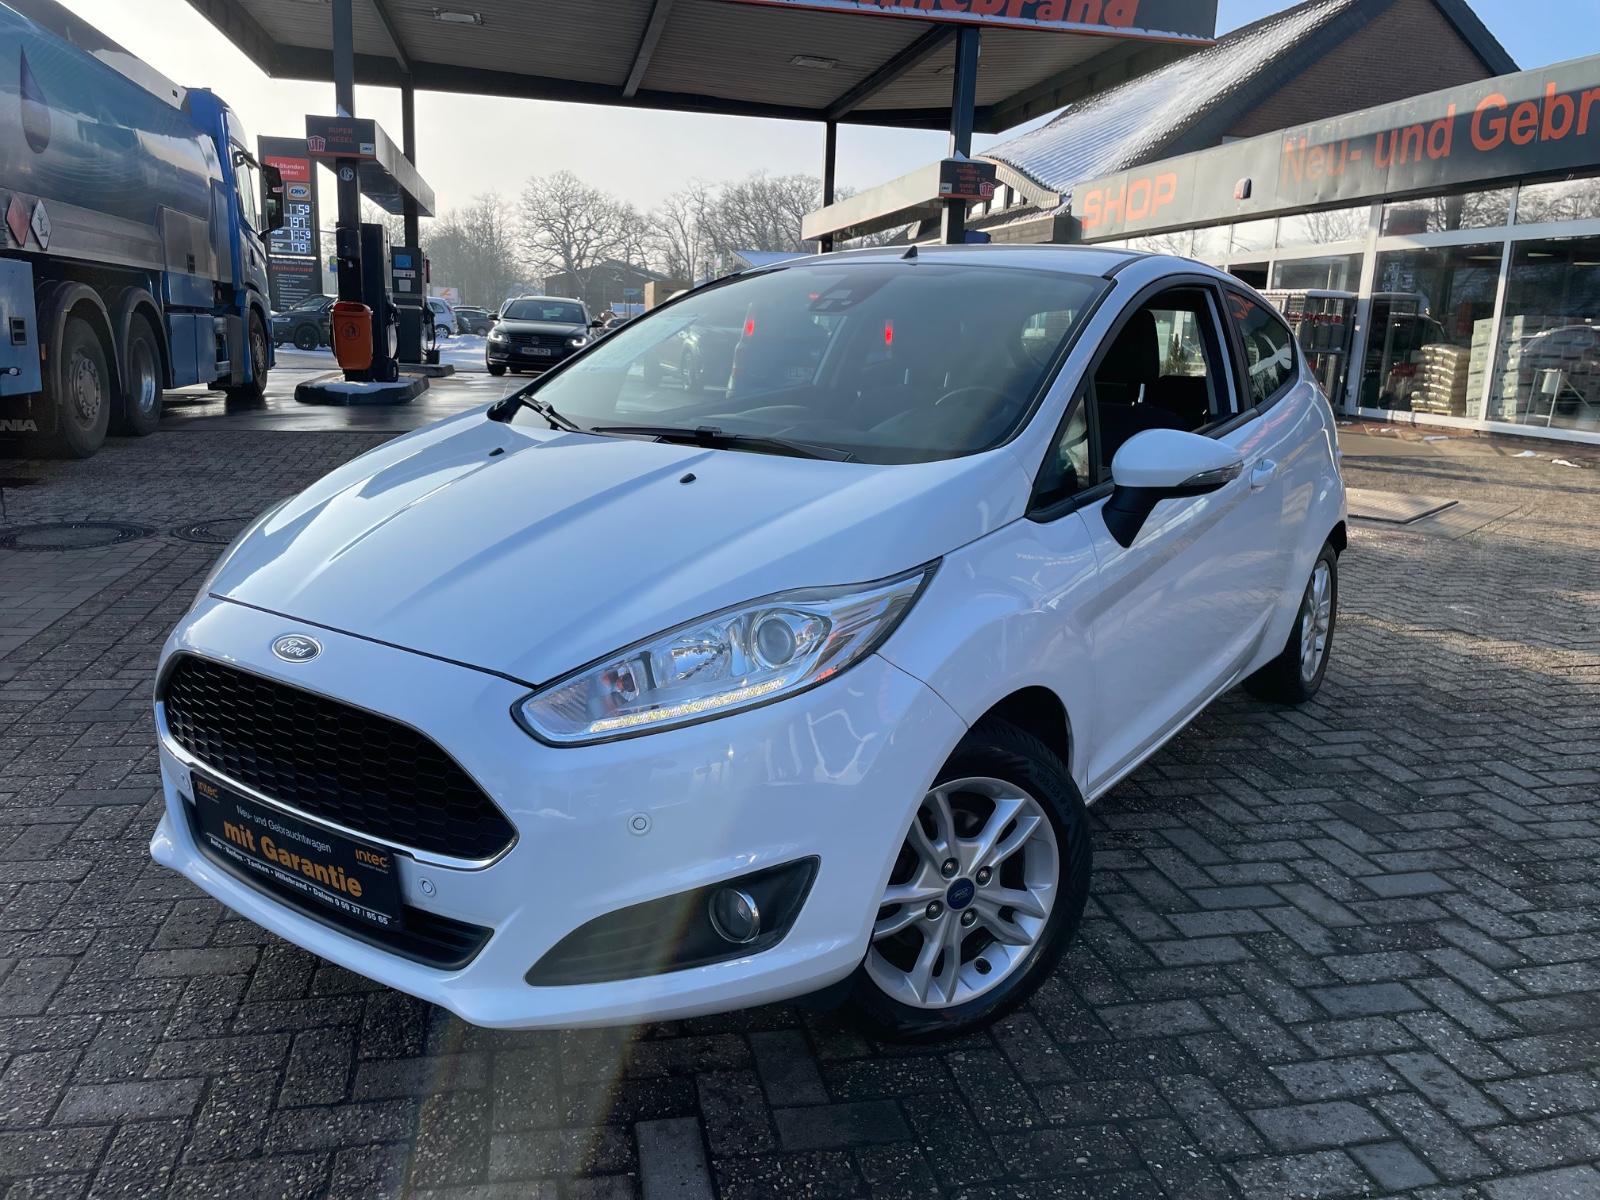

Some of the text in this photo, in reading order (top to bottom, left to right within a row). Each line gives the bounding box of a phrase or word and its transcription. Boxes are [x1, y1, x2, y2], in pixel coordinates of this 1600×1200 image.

[1282, 82, 1600, 186] Neu- und Gebr
[1083, 172, 1177, 229] SHOP
[280, 639, 310, 657] Ford
[236, 804, 332, 853] Neu- und Gebrauchtwagen
[223, 820, 363, 897] mit Garantie
